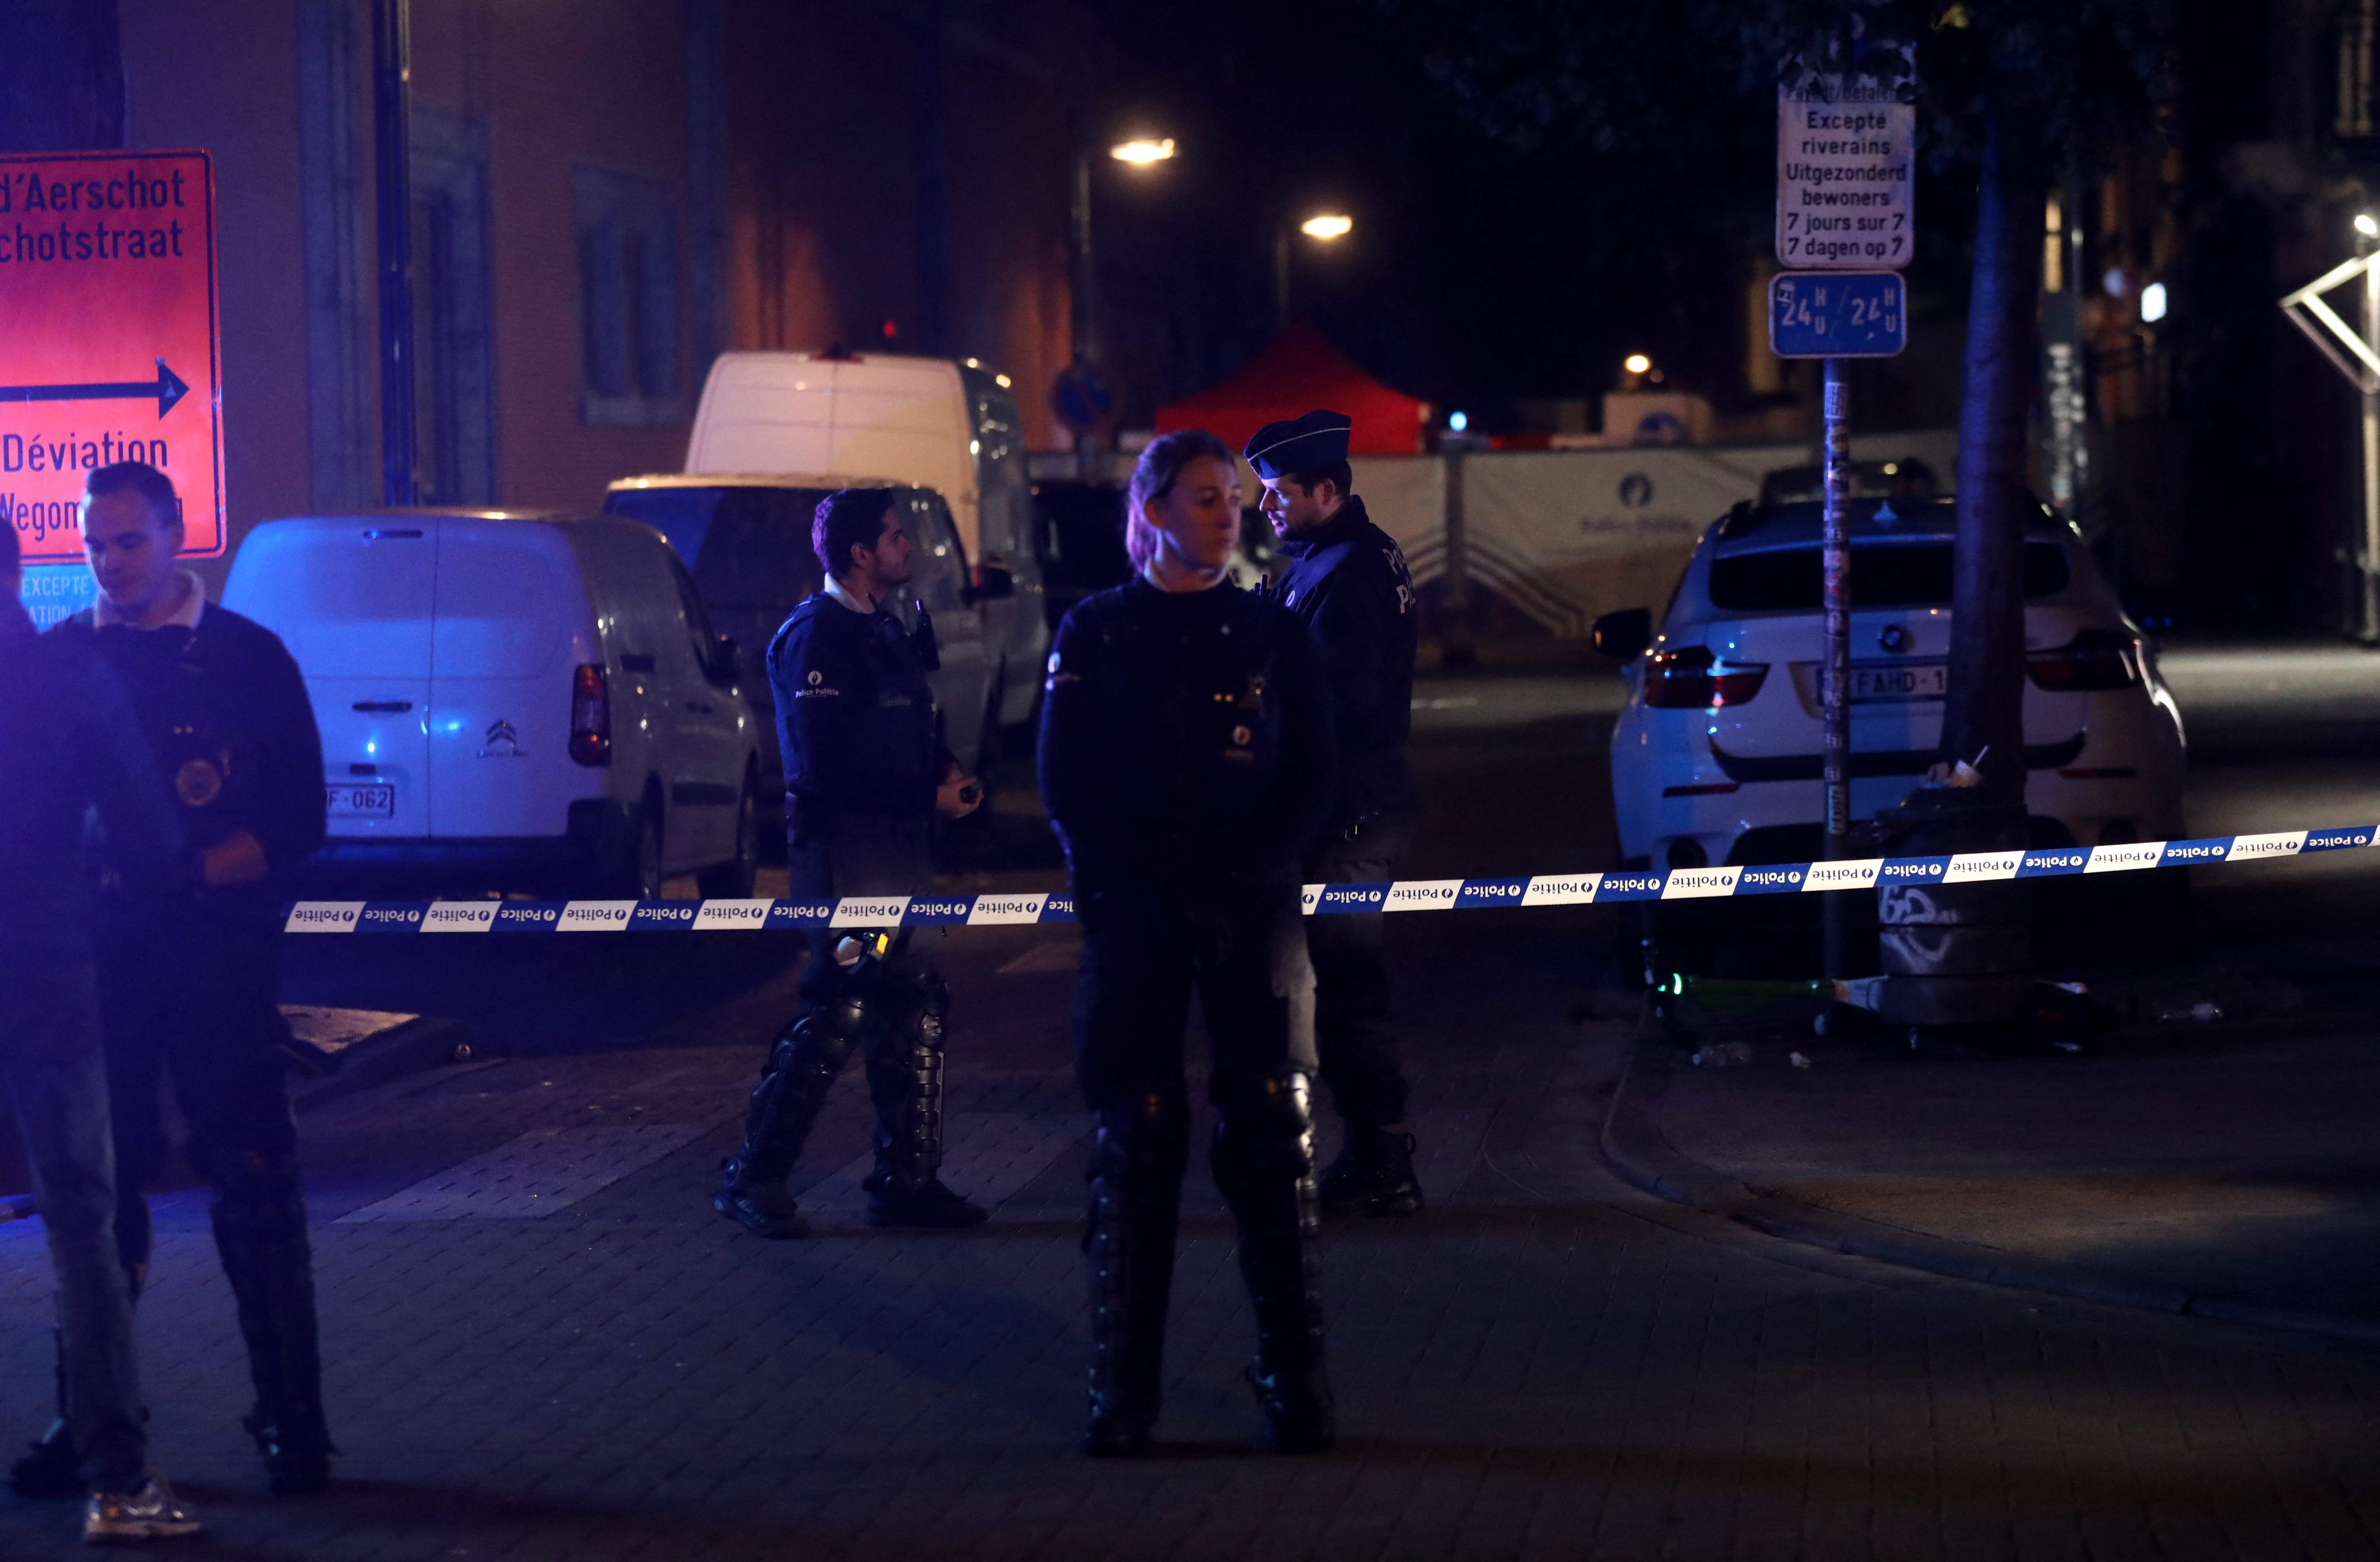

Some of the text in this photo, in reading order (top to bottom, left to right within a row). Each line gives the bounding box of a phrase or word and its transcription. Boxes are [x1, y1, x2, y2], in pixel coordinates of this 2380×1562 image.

[1807, 111, 1886, 132] Excepté
[1802, 138, 1891, 155] riverains
[1786, 163, 1906, 185] Uitgezonderd
[1802, 188, 1890, 206] bewoners
[1787, 213, 1904, 235] 7 jours sur 7
[1787, 238, 1903, 260] 7 dagen op 7
[3, 431, 167, 473] Déviation
[22, 575, 89, 595] EXCEPTE
[1326, 836, 2351, 903] Police Politie Police Politie Police Politie Police Politie Police Politie Police Politie Police Politie Police
[295, 901, 1073, 922] lice Politie Police Politie Police Politie Police Politie Police Politie Police Politie
